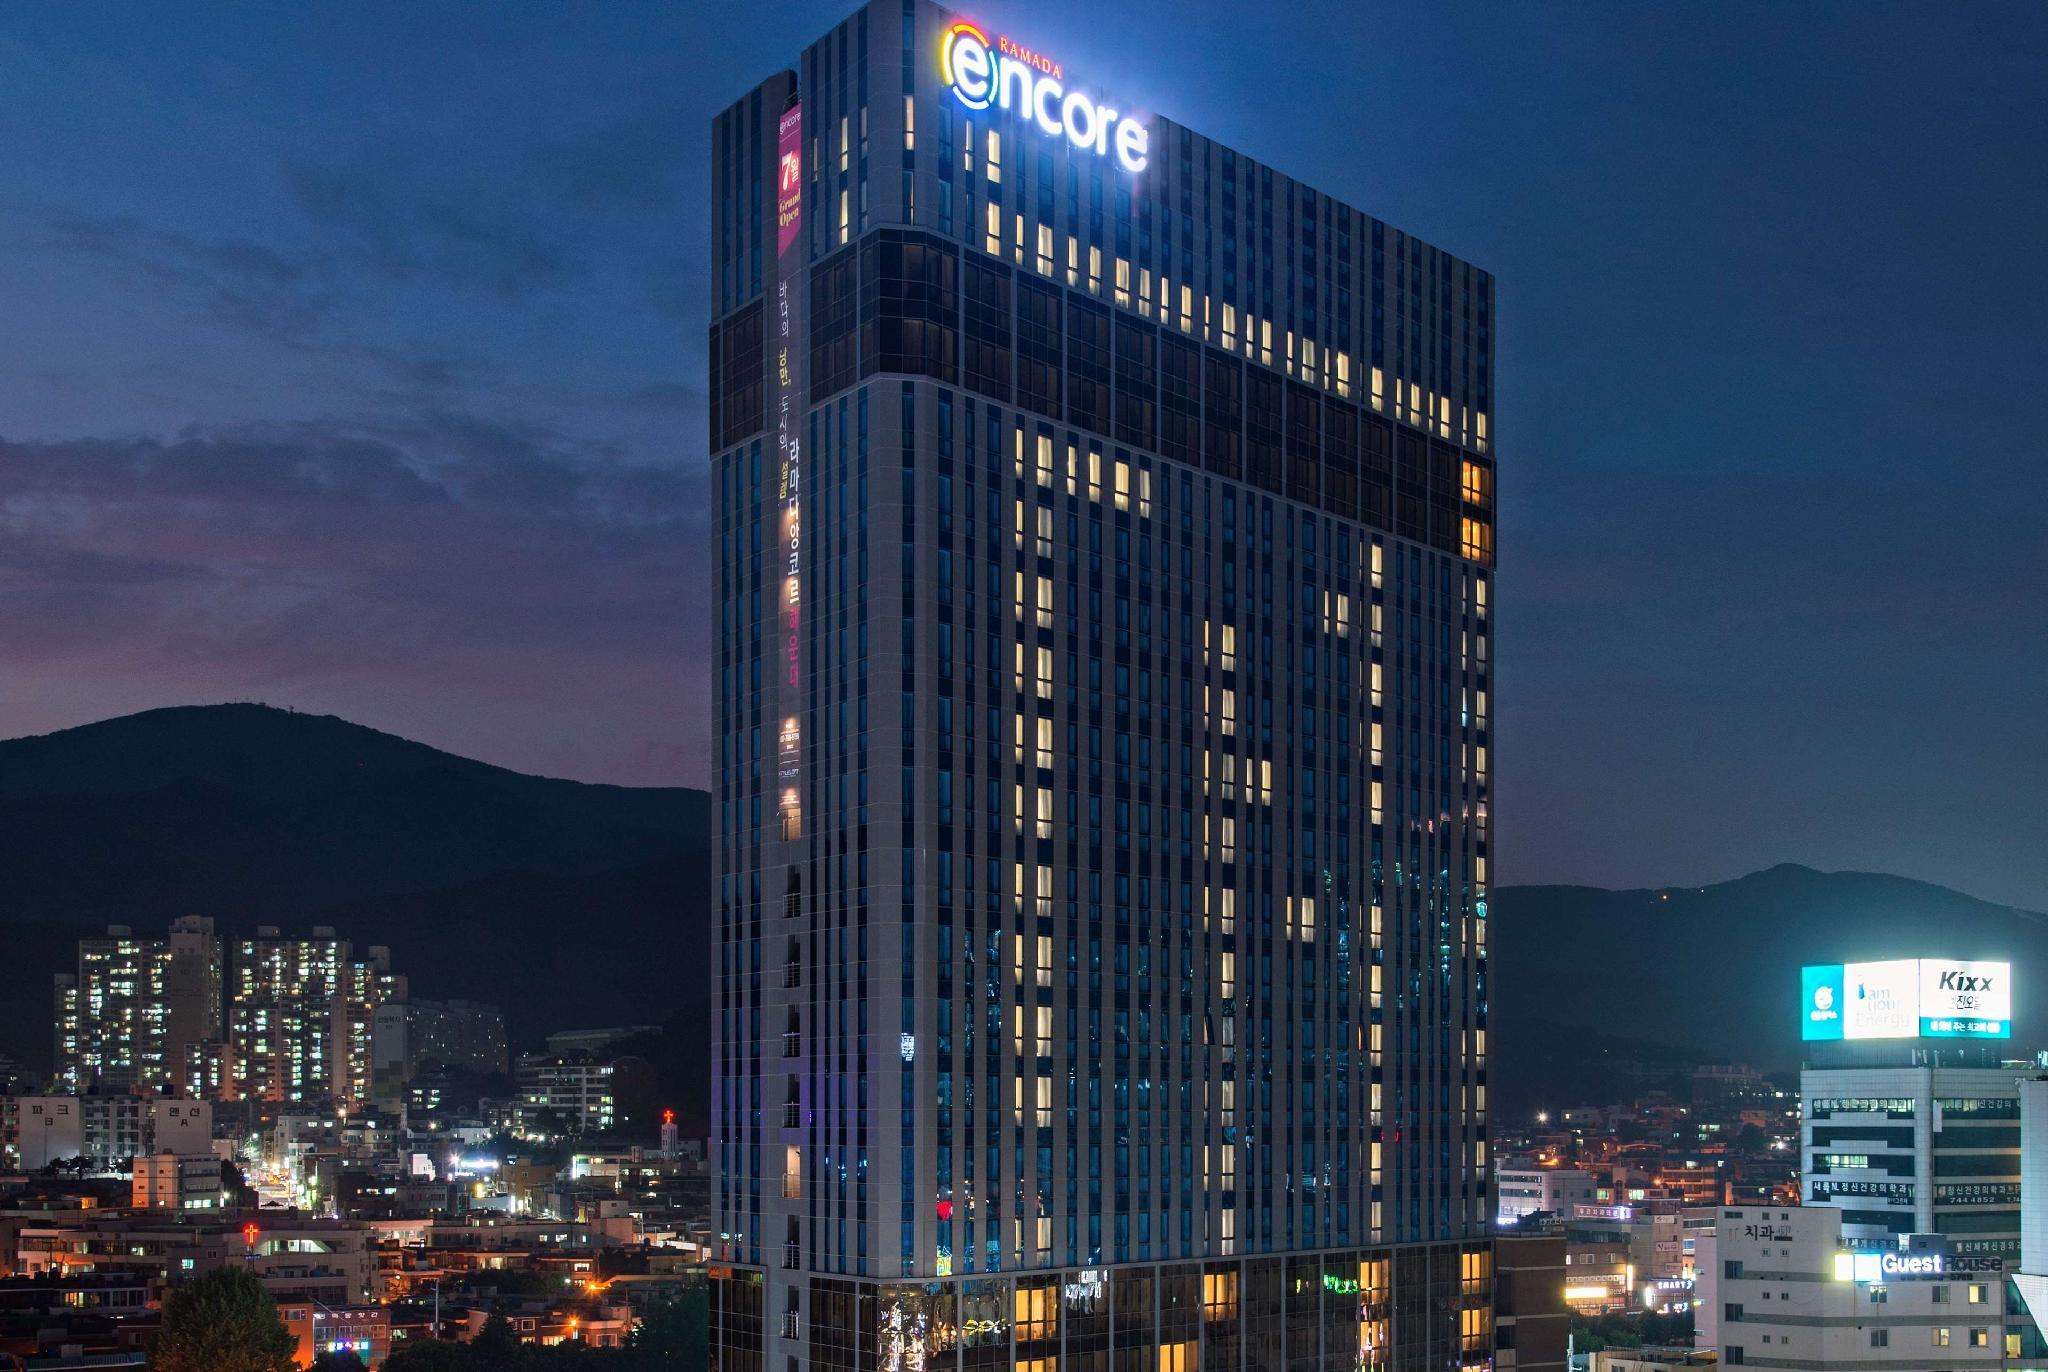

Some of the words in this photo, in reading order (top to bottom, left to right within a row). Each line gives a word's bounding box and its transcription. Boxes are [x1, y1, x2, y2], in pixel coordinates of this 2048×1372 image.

[1000, 37, 1062, 79] RAMADA
[945, 28, 1148, 172] encore
[779, 189, 801, 213] Grand
[779, 207, 799, 227] Open
[779, 281, 789, 336] 바다의
[1939, 971, 1994, 992] Kixx
[181, 1118, 188, 1127] A
[1745, 1225, 1775, 1241] 치과
[1882, 1254, 1941, 1273] Guest
